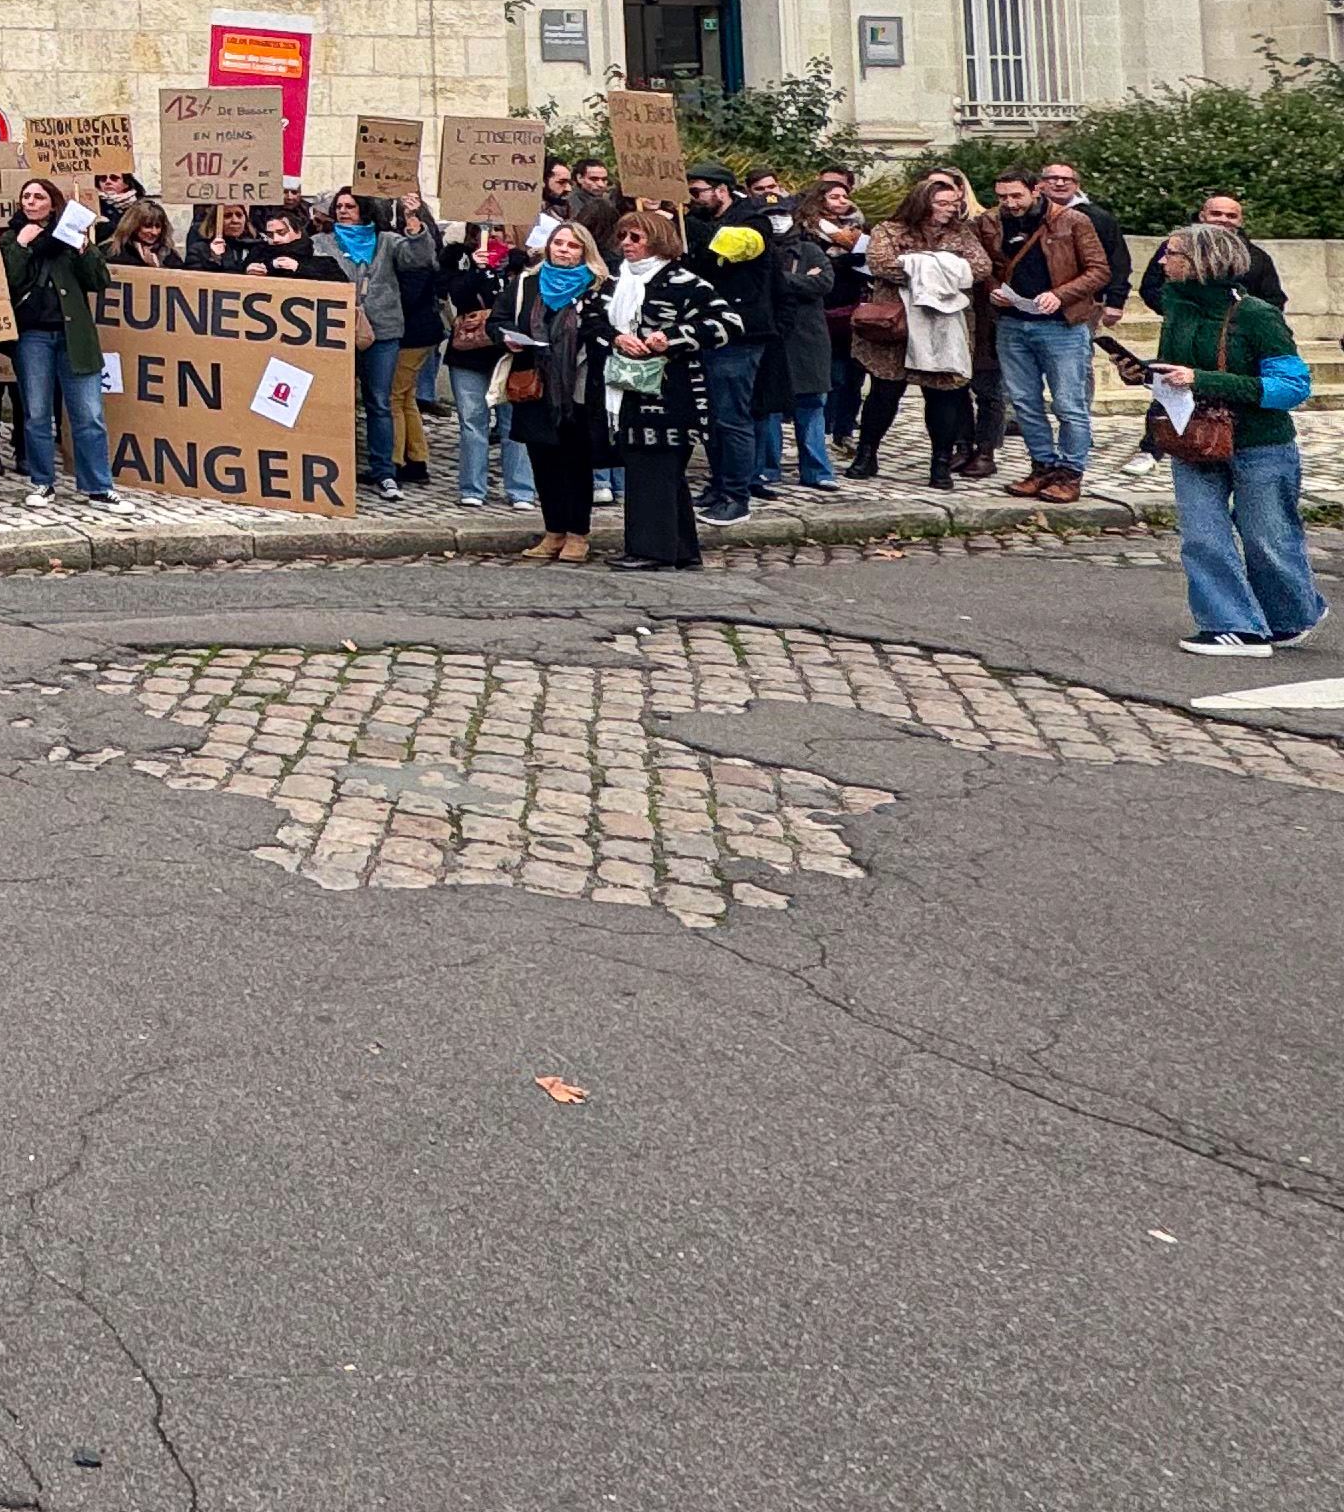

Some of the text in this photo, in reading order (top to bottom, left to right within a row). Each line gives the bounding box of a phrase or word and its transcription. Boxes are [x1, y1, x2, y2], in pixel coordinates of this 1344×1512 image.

[77, 117, 129, 135] LOCALE
[194, 132, 210, 141] EN
[175, 152, 249, 178] 100 %
[512, 153, 536, 165] PAS
[483, 179, 537, 193] OPTION
[95, 280, 347, 349] EUNESSE
[137, 355, 222, 410] EN
[112, 432, 344, 507] ANGER
